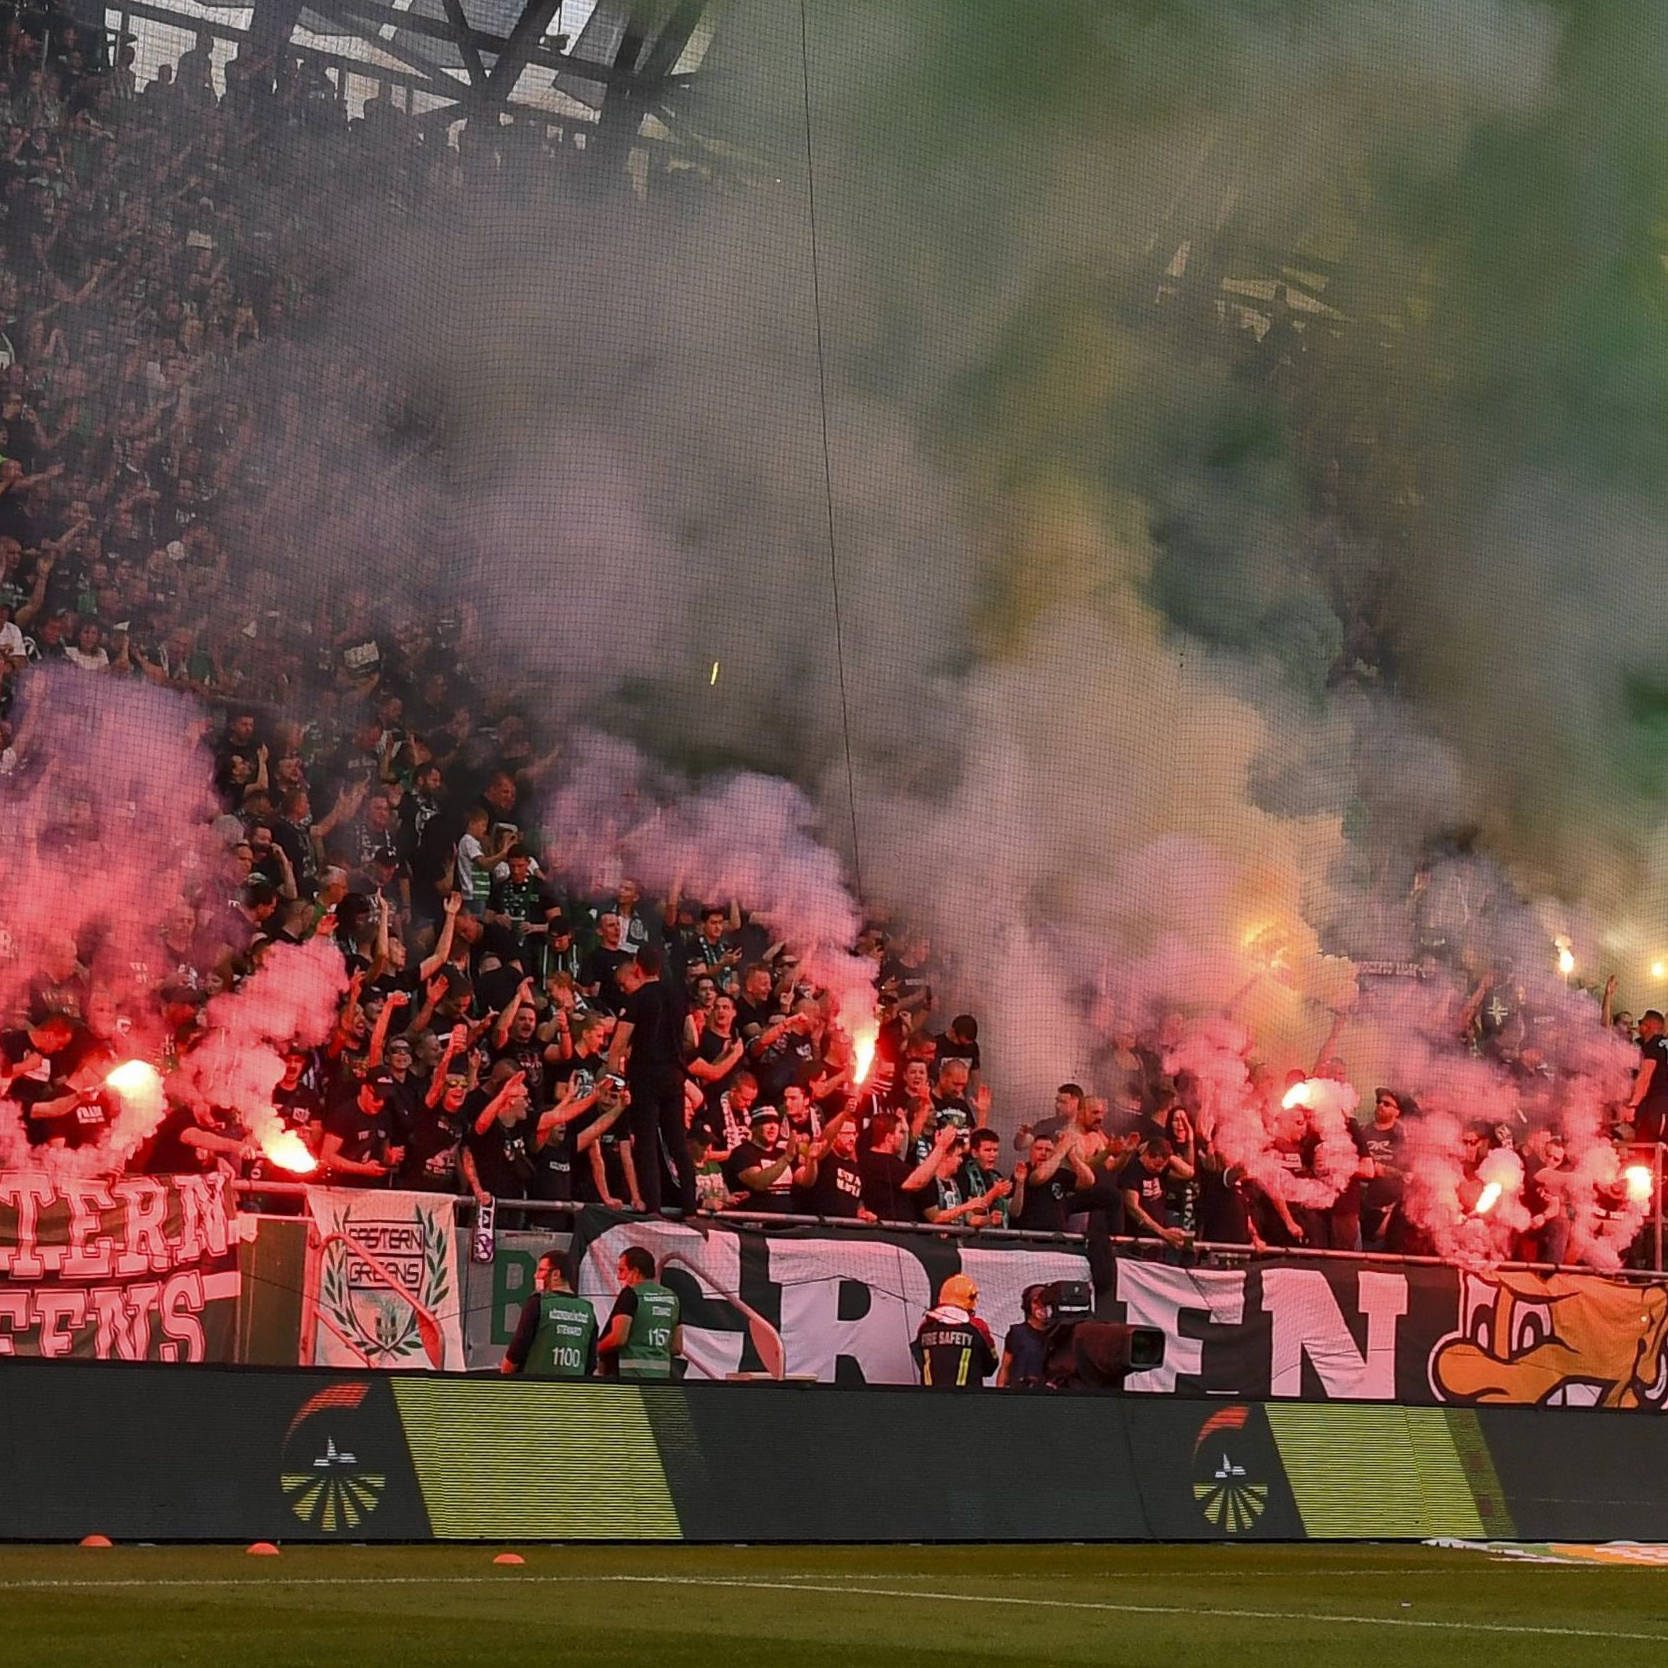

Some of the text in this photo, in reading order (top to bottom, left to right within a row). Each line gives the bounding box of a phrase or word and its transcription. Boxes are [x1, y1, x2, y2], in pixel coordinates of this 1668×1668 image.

[349, 1261, 421, 1284] GREENS
[579, 1220, 1408, 1400] GREEN
[938, 1331, 973, 1346] SAFETY
[552, 1346, 581, 1368] 1100
